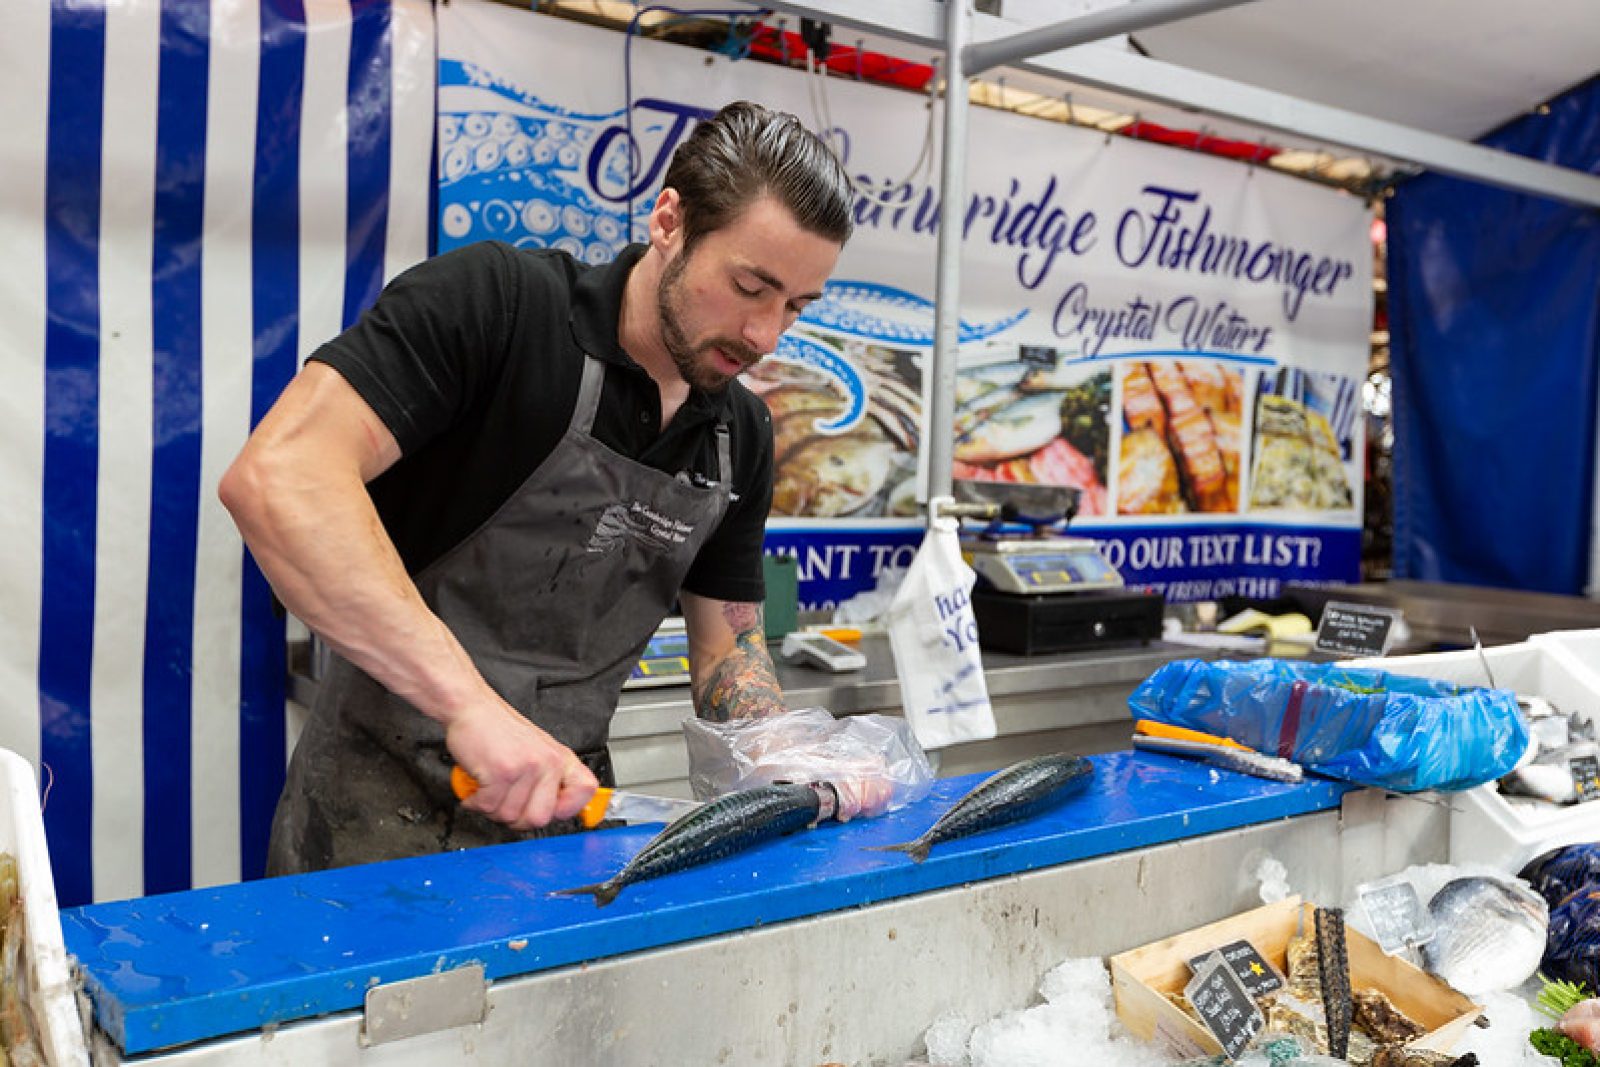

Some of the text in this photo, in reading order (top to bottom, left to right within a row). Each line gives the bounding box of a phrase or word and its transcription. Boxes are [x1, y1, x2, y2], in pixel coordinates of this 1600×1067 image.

[1115, 185, 1353, 322] Fishmonger
[1053, 282, 1274, 359] Crystal Waters
[1130, 536, 1184, 570] OUR
[1188, 534, 1240, 567] TEXT
[1243, 534, 1323, 567] LIST?
